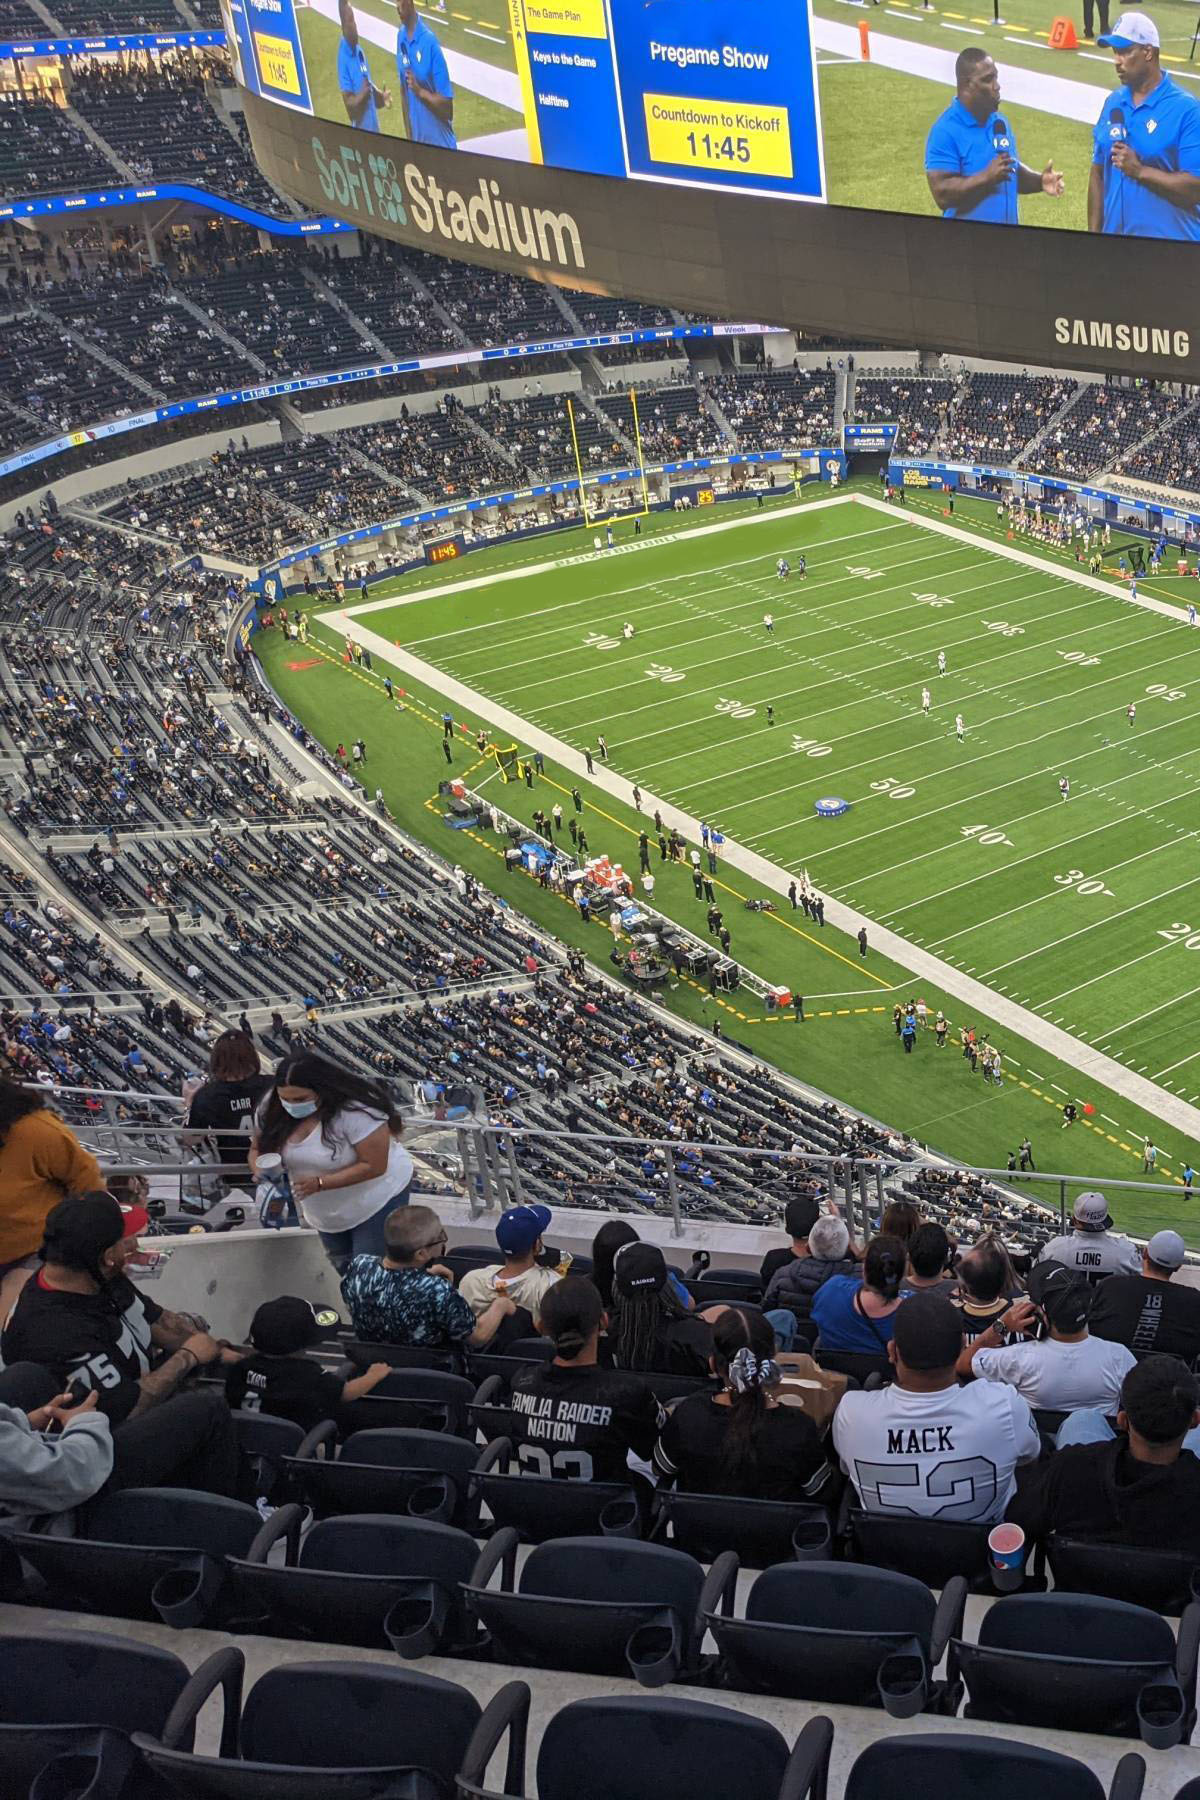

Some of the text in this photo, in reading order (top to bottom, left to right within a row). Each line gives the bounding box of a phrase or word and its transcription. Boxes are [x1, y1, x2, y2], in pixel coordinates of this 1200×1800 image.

[528, 7, 581, 22] The Game Plan
[533, 50, 597, 68] Keys to the Game
[650, 42, 769, 70] Pregame Show
[652, 105, 780, 132] Countdown to Kickoff
[687, 132, 750, 162] 11:45
[312, 136, 585, 268] SoFi Stadium
[1055, 316, 1190, 358] SAMSUNG
[250, 388, 270, 399] 11:45
[432, 544, 456, 561] 11:45
[850, 566, 886, 580] 10
[914, 592, 955, 607] 20
[987, 621, 1025, 636] 30
[583, 633, 621, 650] 10
[1063, 652, 1101, 665] 40
[645, 666, 686, 683] 20
[1146, 684, 1186, 701] 50
[714, 699, 757, 718] 30
[790, 738, 833, 757] 40
[870, 777, 916, 799] 50
[960, 823, 1007, 845] 40
[1054, 869, 1105, 895] 30
[230, 1097, 252, 1112] CARR
[1076, 1252, 1101, 1266] LONG
[1145, 1294, 1163, 1309] 18
[66, 1353, 121, 1389] 75
[512, 1391, 612, 1426] FAMILIA RAIDER
[528, 1418, 577, 1443] NATION
[887, 1425, 955, 1455] MACK
